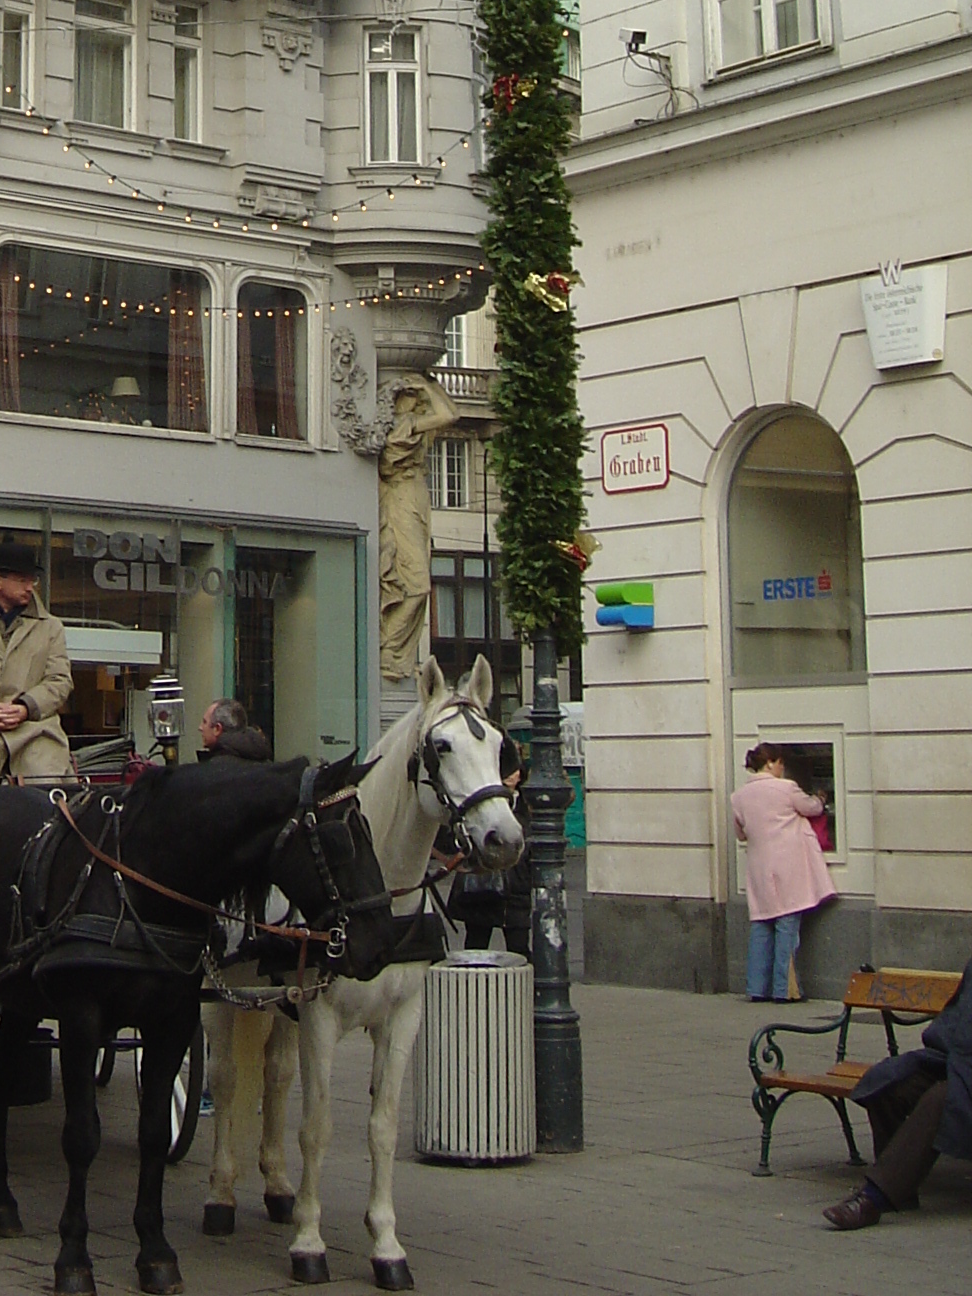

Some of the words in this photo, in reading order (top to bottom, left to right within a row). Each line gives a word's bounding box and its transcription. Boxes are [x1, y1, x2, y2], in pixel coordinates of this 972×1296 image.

[609, 450, 661, 478] Graben
[73, 528, 177, 564] DON
[763, 576, 816, 601] ERSTE
